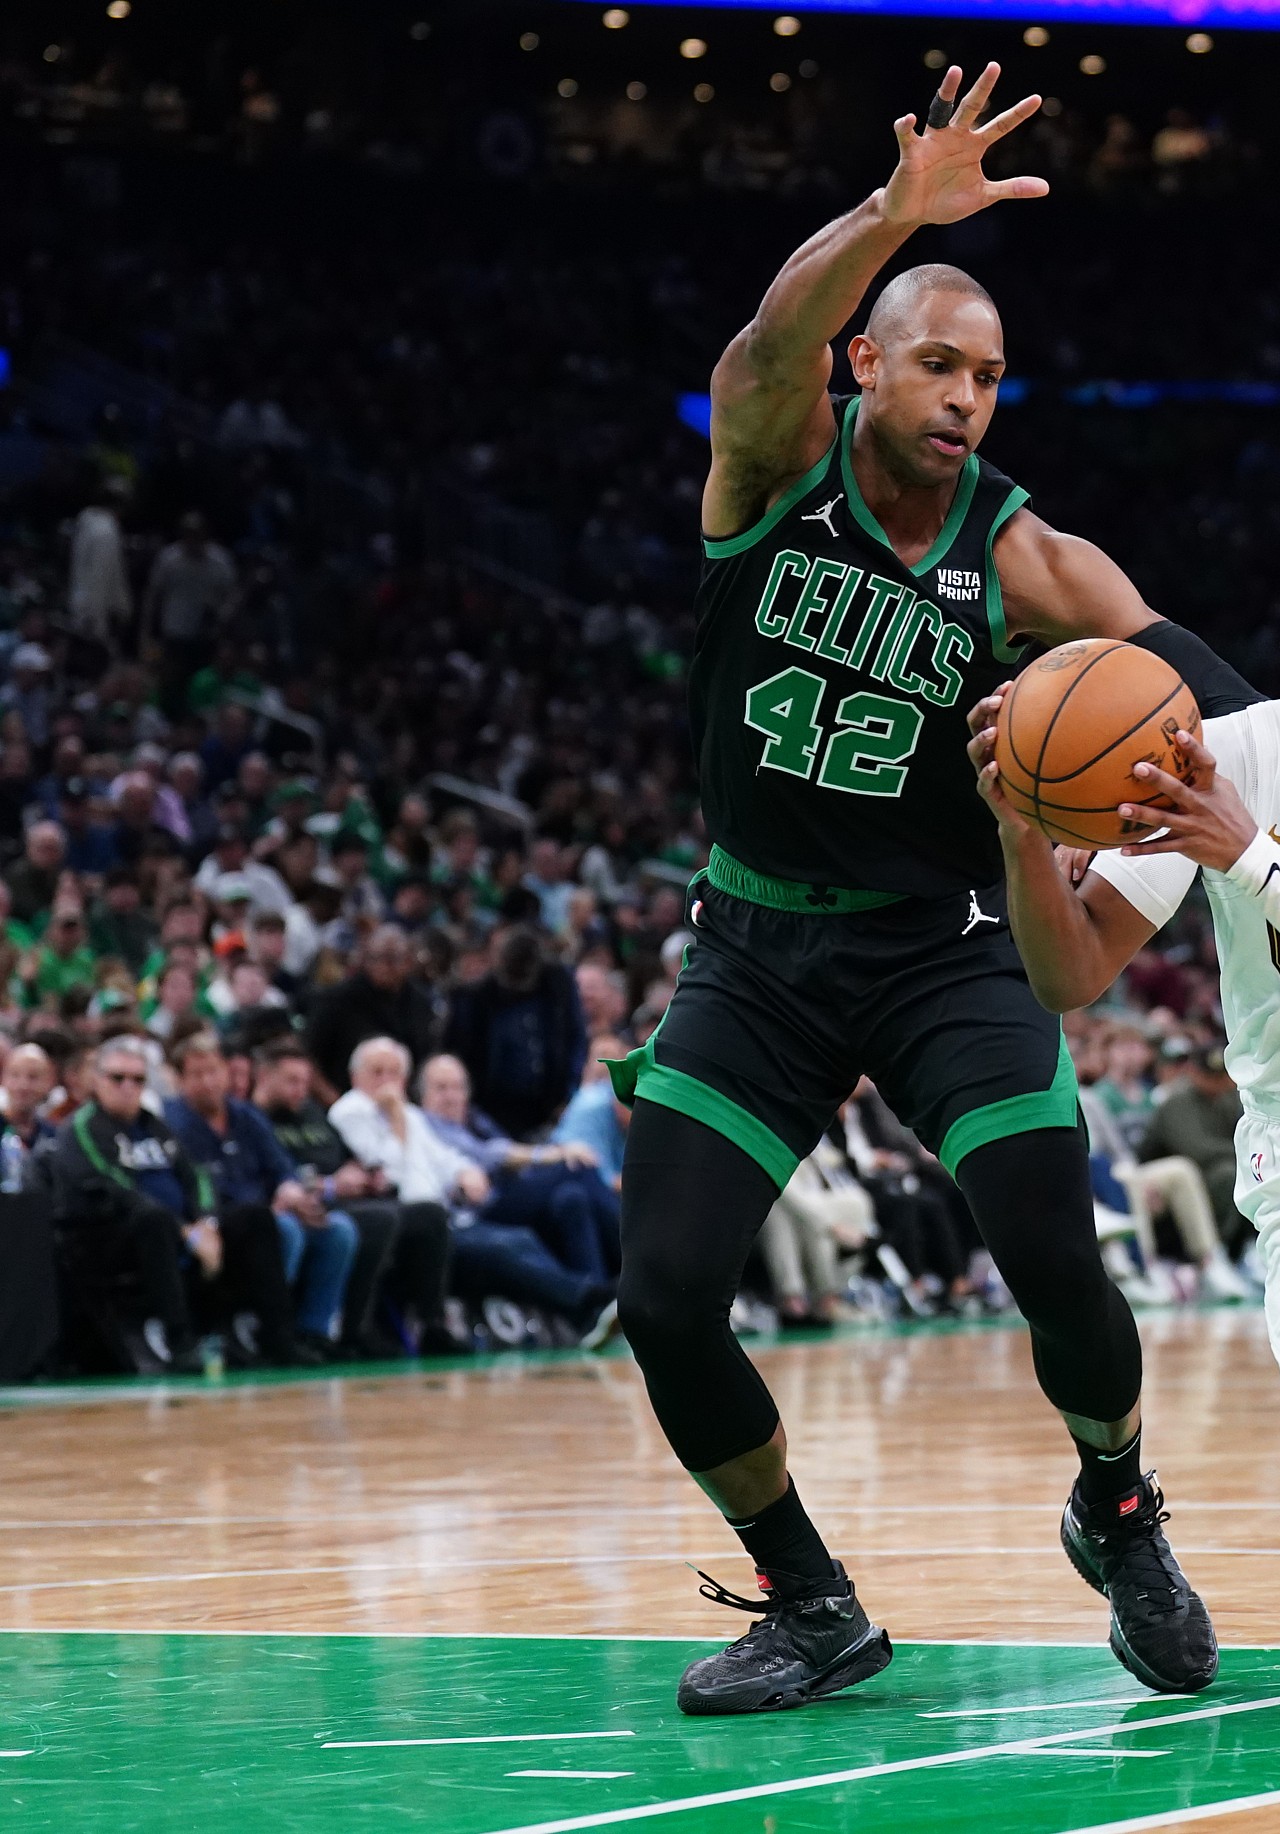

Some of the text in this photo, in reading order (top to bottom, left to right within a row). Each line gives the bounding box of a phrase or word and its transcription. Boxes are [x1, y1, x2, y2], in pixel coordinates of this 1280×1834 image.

[937, 568, 981, 587] VISTA
[937, 583, 981, 601] PRINT
[755, 548, 974, 707] CELTICS
[744, 665, 925, 797] 42
